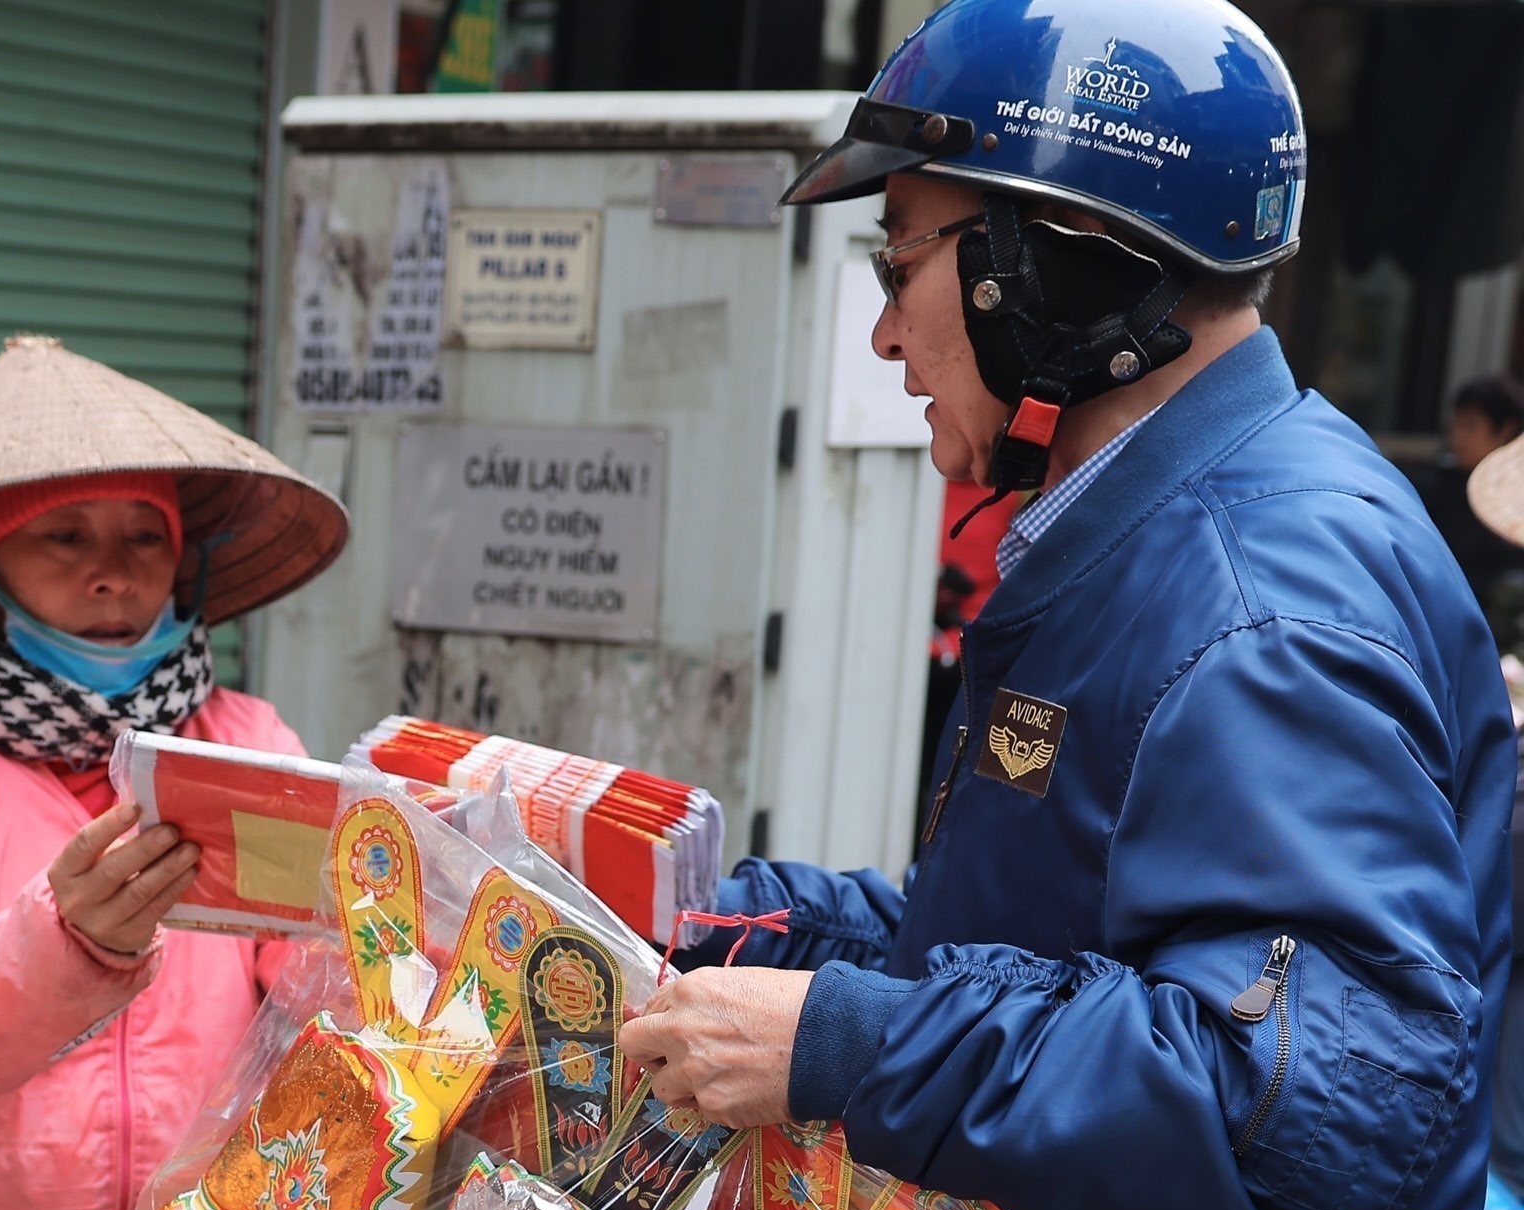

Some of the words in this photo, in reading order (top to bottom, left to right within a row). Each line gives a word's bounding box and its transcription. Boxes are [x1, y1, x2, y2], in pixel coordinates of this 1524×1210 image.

[1067, 66, 1150, 99] WORLD
[996, 100, 1029, 118] THẾ
[1027, 107, 1064, 125] GIỚI
[1067, 112, 1102, 134] BẤT
[1103, 121, 1155, 148] ĐỘNG
[1156, 135, 1193, 160] SẢN
[1004, 121, 1019, 135] Đại
[1020, 124, 1029, 138] lý
[1030, 126, 1054, 139] chiến
[1054, 130, 1074, 143] lược
[1075, 135, 1091, 147] của
[1269, 129, 1288, 153] THẾ
[479, 256, 548, 280] PILLAR
[463, 442, 523, 490] CẤM
[482, 545, 552, 571] NGUY
[1007, 700, 1054, 731] AVIDACE
